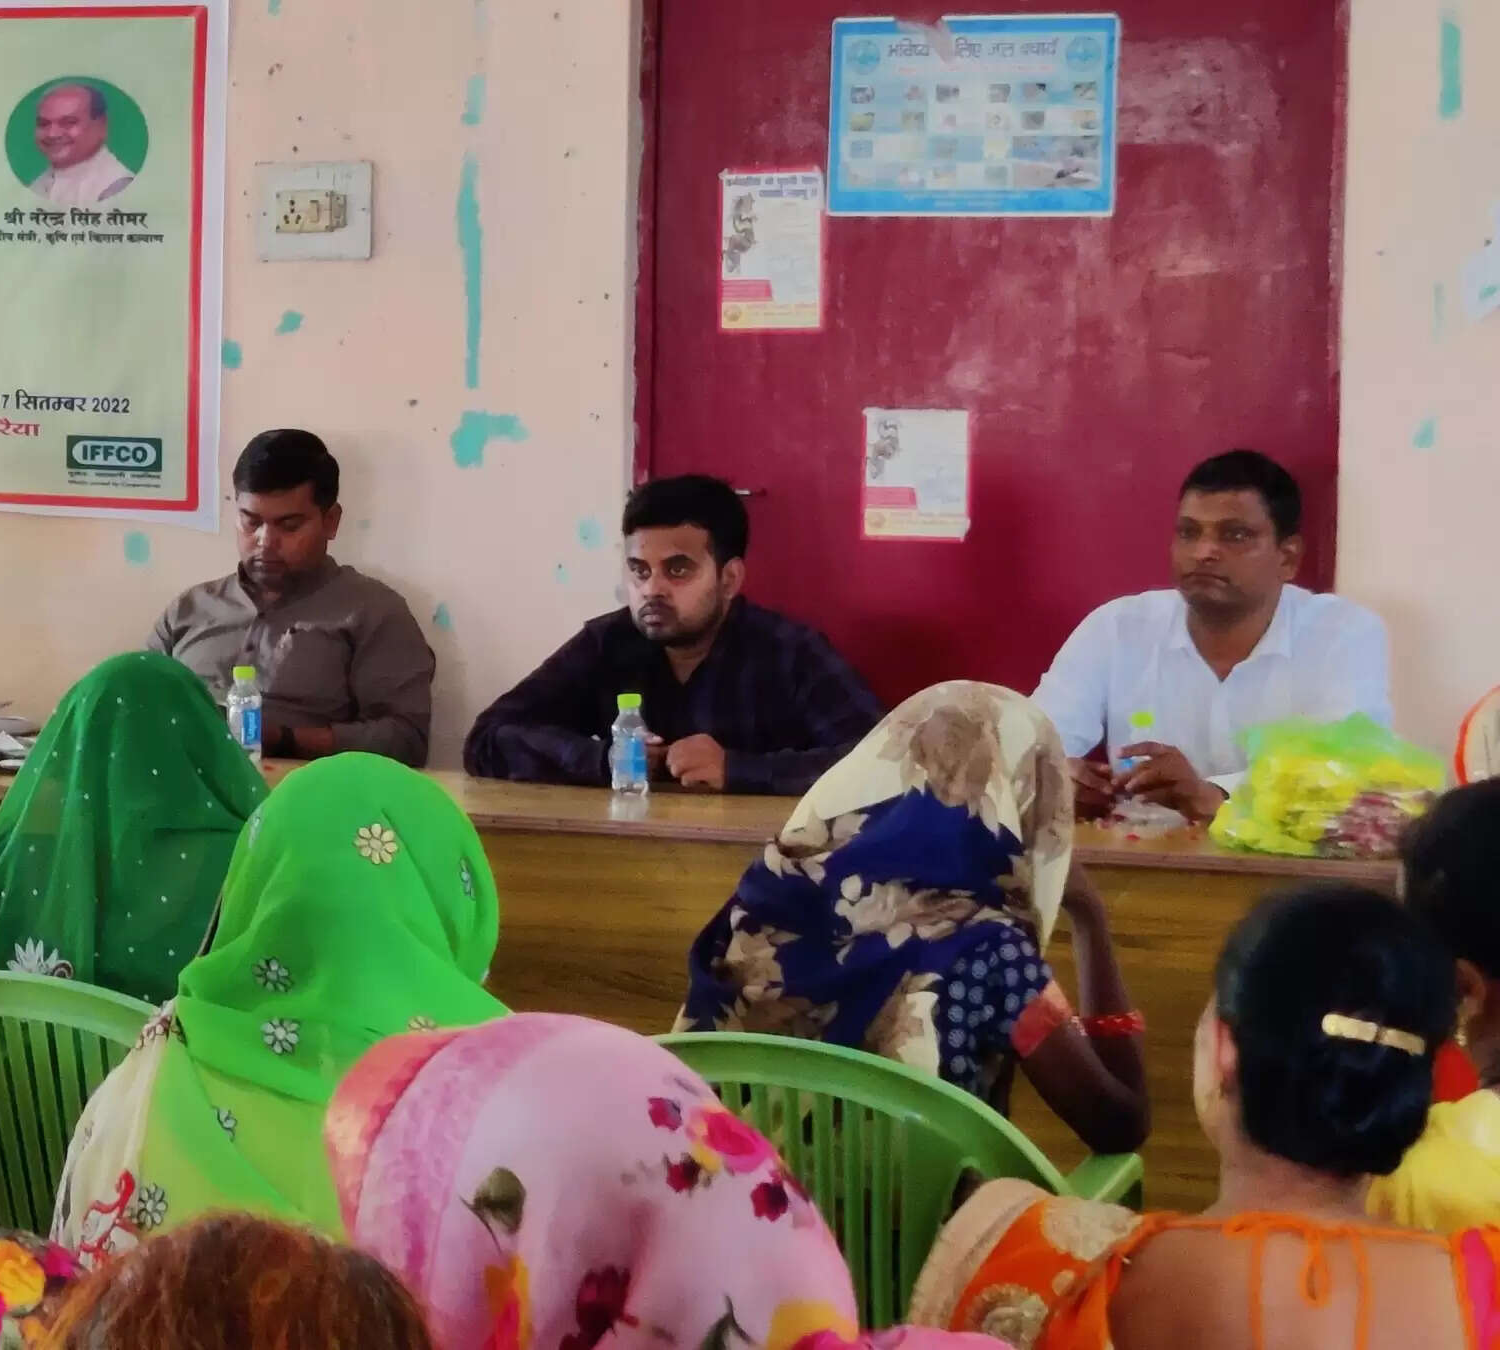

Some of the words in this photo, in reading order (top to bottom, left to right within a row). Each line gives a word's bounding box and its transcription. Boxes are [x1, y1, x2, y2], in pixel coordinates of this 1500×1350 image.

[4, 207, 25, 225] श्री
[70, 207, 102, 226] सिंह
[107, 208, 148, 227] तोमर
[15, 389, 87, 413] सितम्बर
[92, 397, 131, 414] 2022
[82, 443, 148, 464] IFFCO
